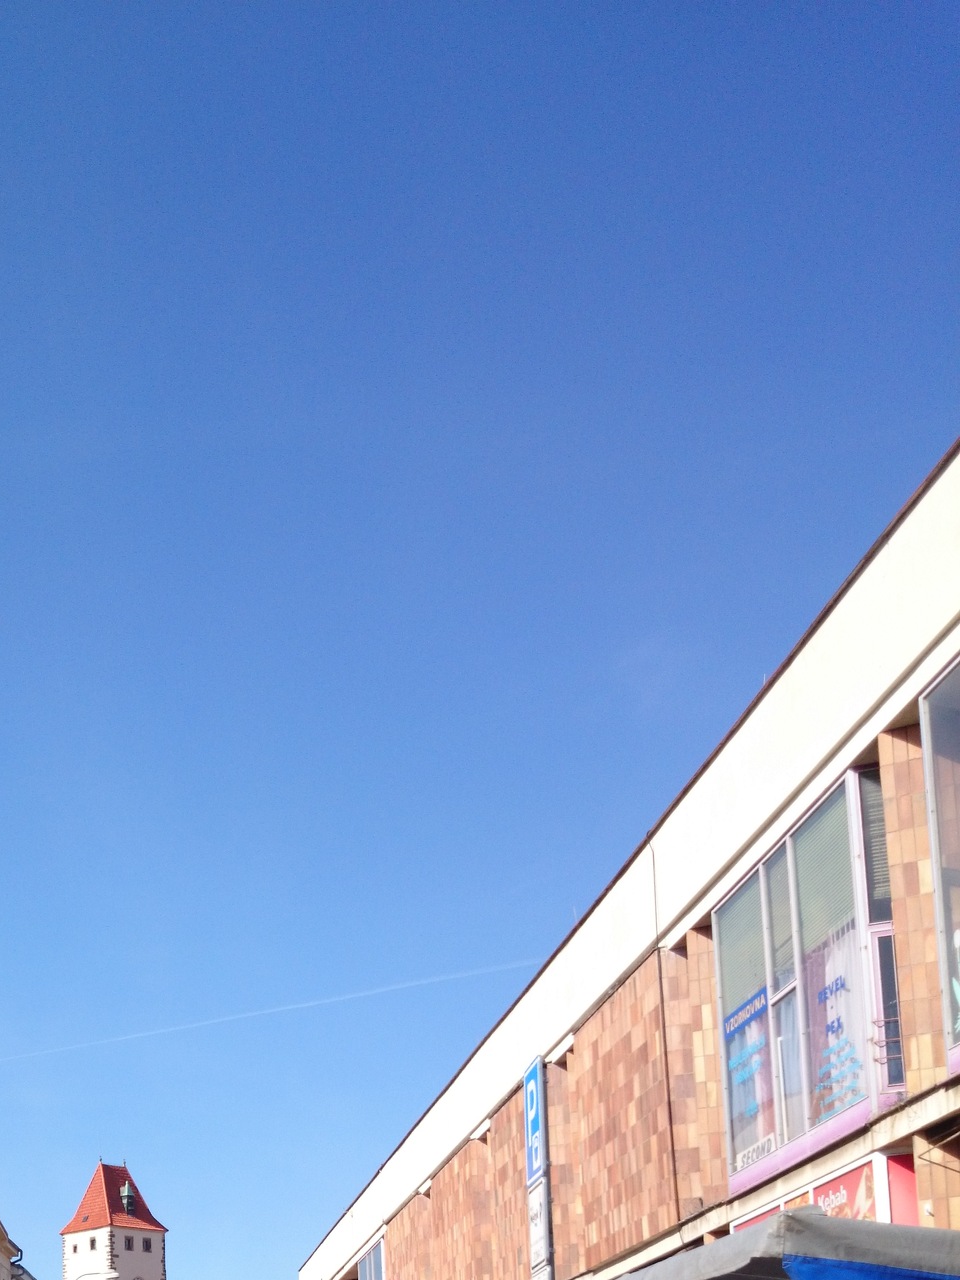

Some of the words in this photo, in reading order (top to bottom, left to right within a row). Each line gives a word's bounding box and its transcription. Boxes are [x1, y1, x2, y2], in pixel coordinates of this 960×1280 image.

[818, 975, 845, 1004] REVEL
[725, 994, 766, 1034] VZORKOVNA
[740, 1140, 772, 1169] SECOND
[817, 1185, 847, 1212] Kebab
